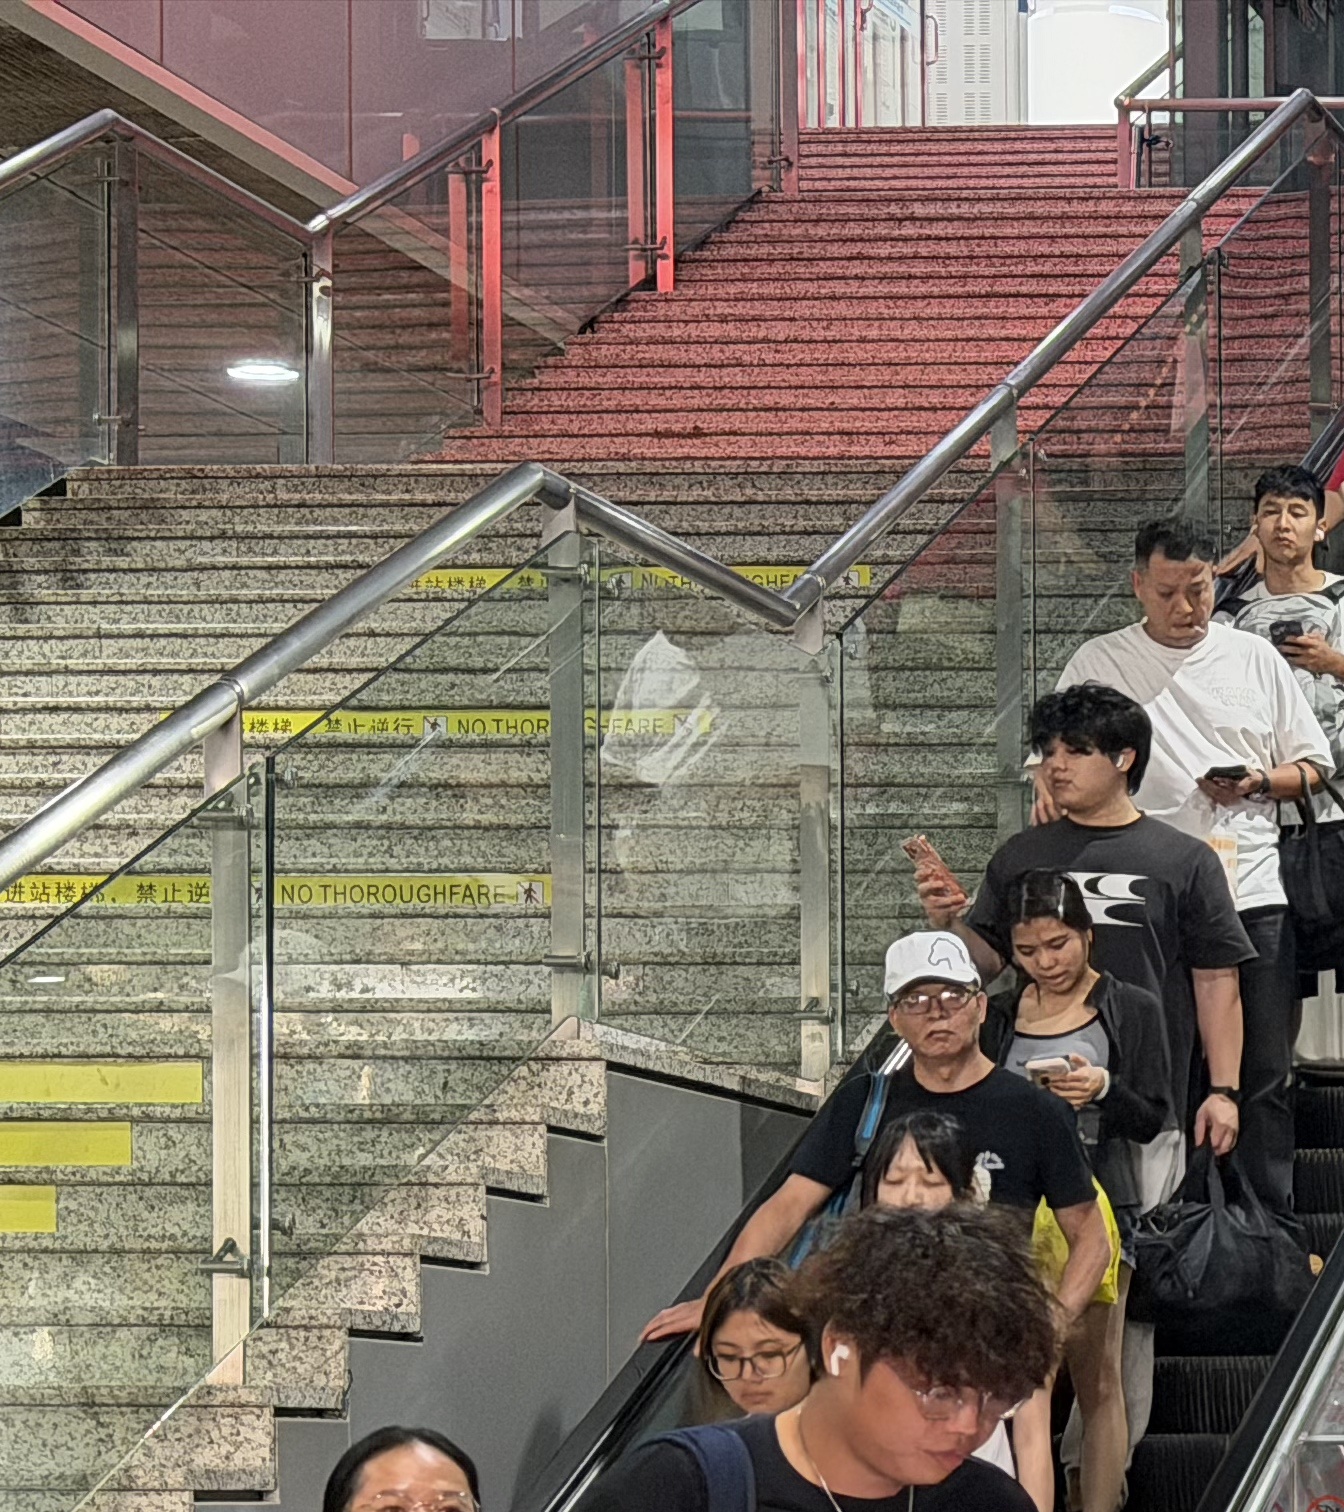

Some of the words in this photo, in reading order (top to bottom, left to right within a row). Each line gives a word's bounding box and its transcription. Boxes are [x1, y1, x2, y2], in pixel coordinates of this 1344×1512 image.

[458, 718, 486, 734] NO
[281, 884, 313, 904] NO
[319, 884, 506, 906] THOROUGHFARE
